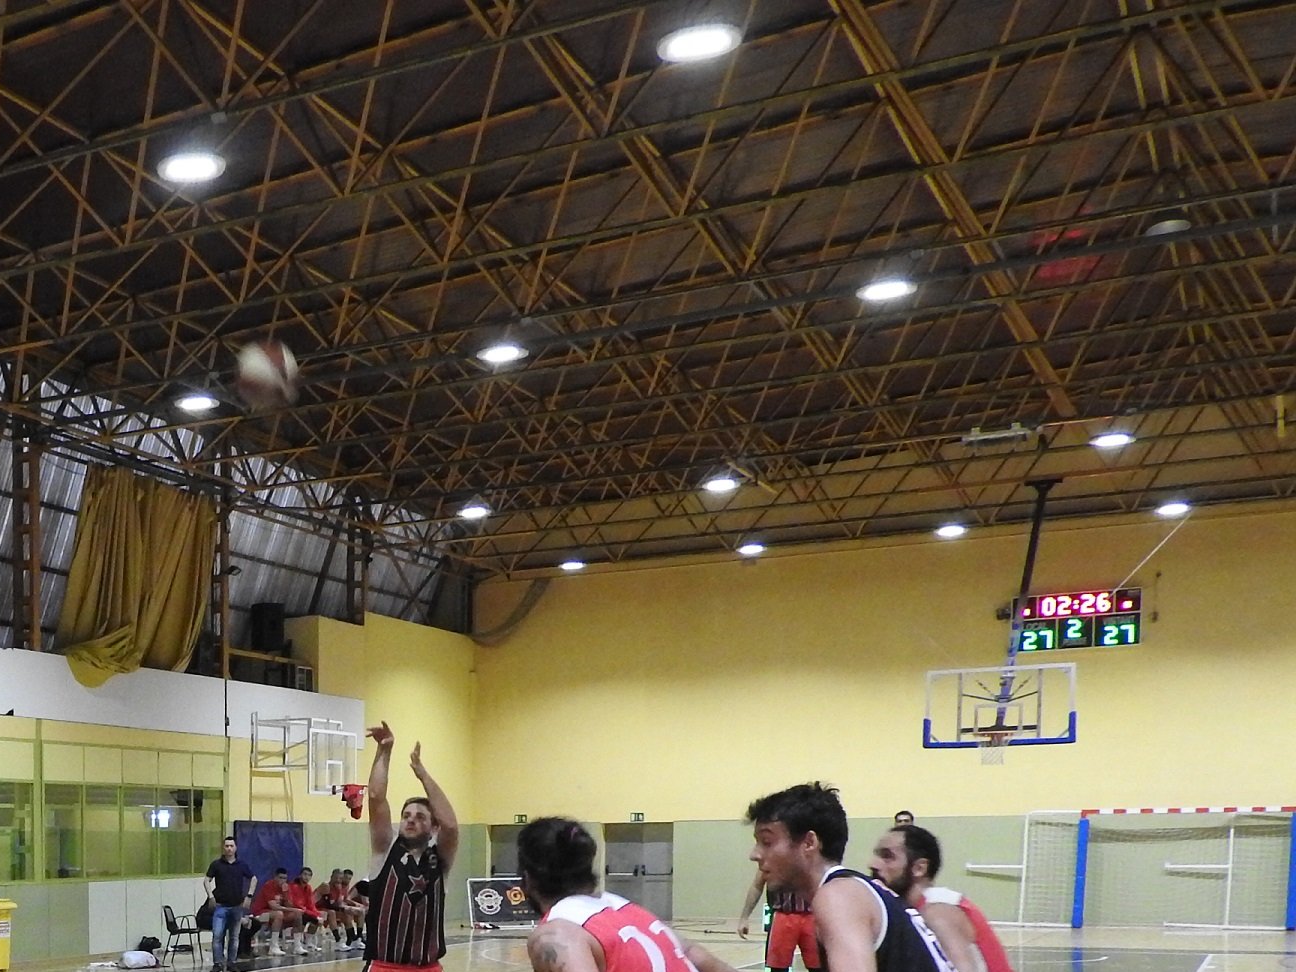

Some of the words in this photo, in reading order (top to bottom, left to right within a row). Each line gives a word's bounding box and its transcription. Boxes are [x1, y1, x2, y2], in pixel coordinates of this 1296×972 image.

[1041, 592, 1112, 617] 02:26
[1022, 630, 1054, 651] 27
[1066, 618, 1083, 639] 2
[1104, 624, 1136, 645] 27
